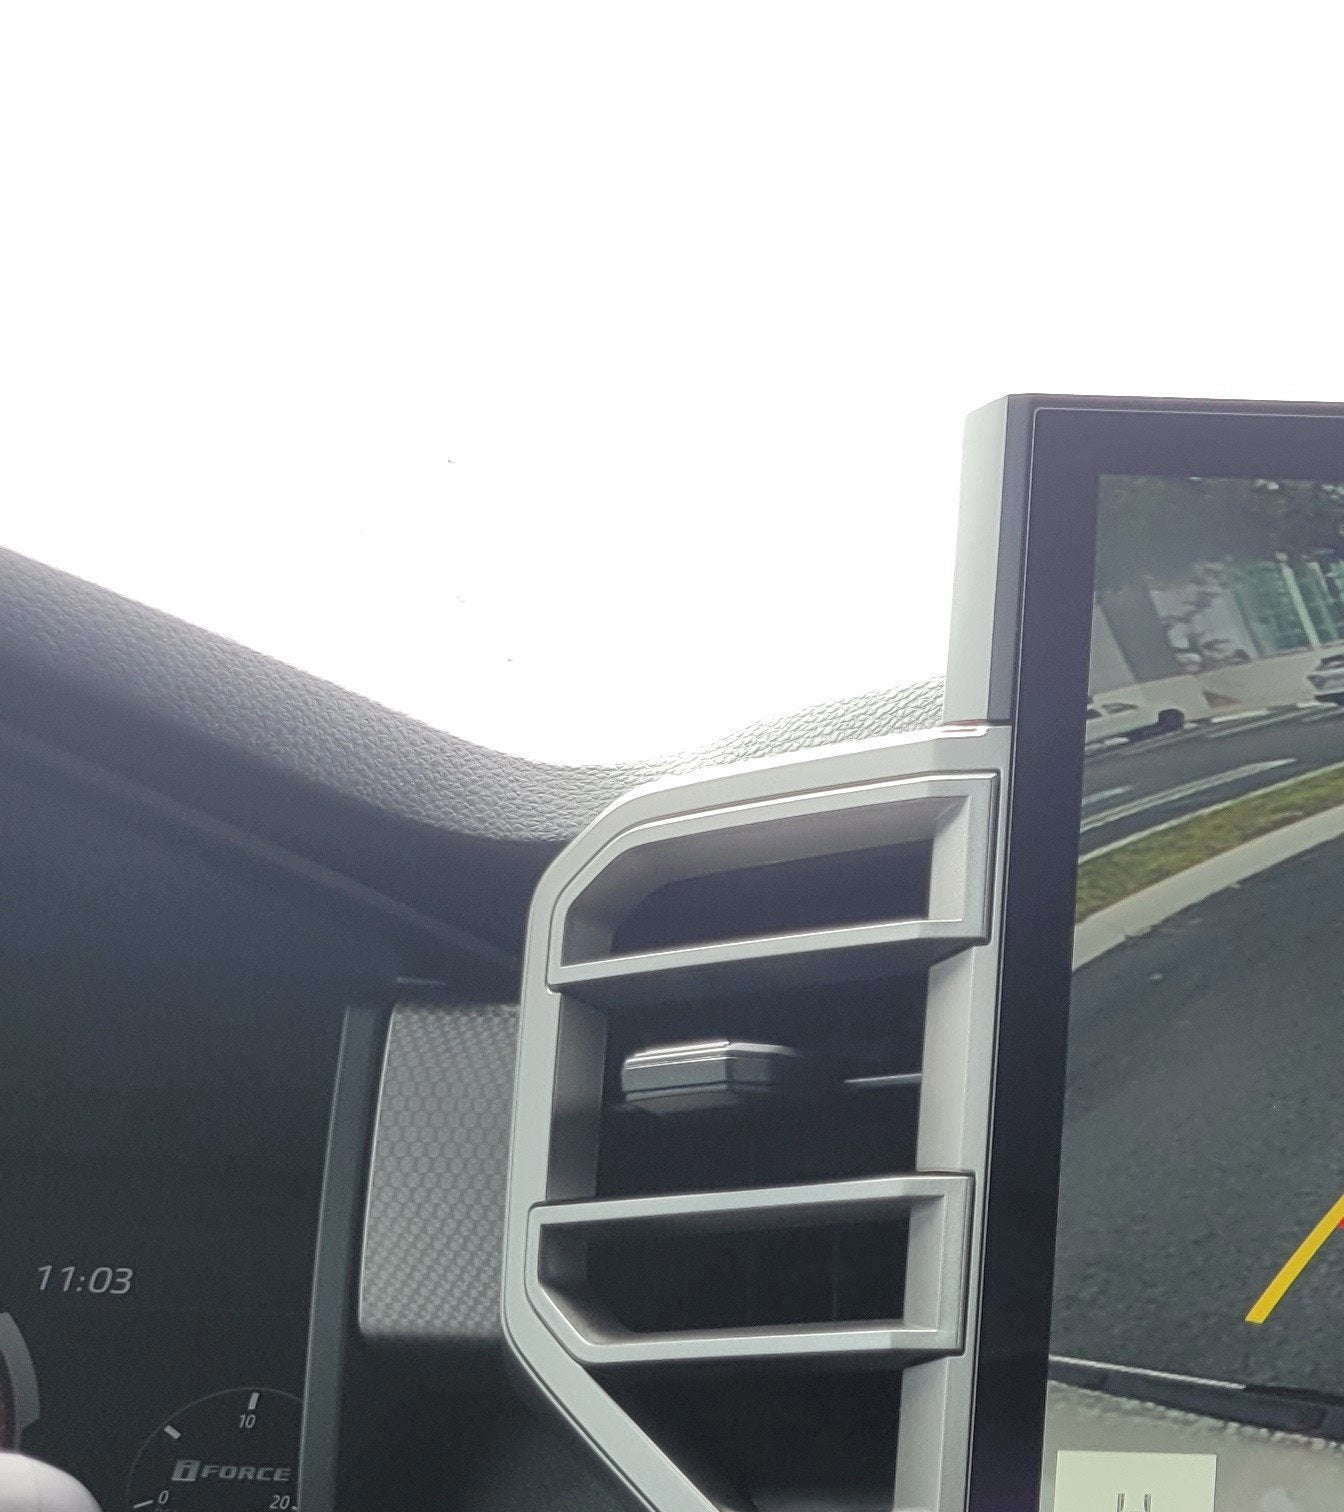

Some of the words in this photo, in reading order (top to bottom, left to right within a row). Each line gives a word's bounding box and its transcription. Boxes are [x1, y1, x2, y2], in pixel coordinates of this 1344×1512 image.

[36, 1264, 135, 1296] 11:03
[238, 1413, 257, 1430] 10
[157, 1489, 170, 1506] 0
[269, 1494, 291, 1511] 20
